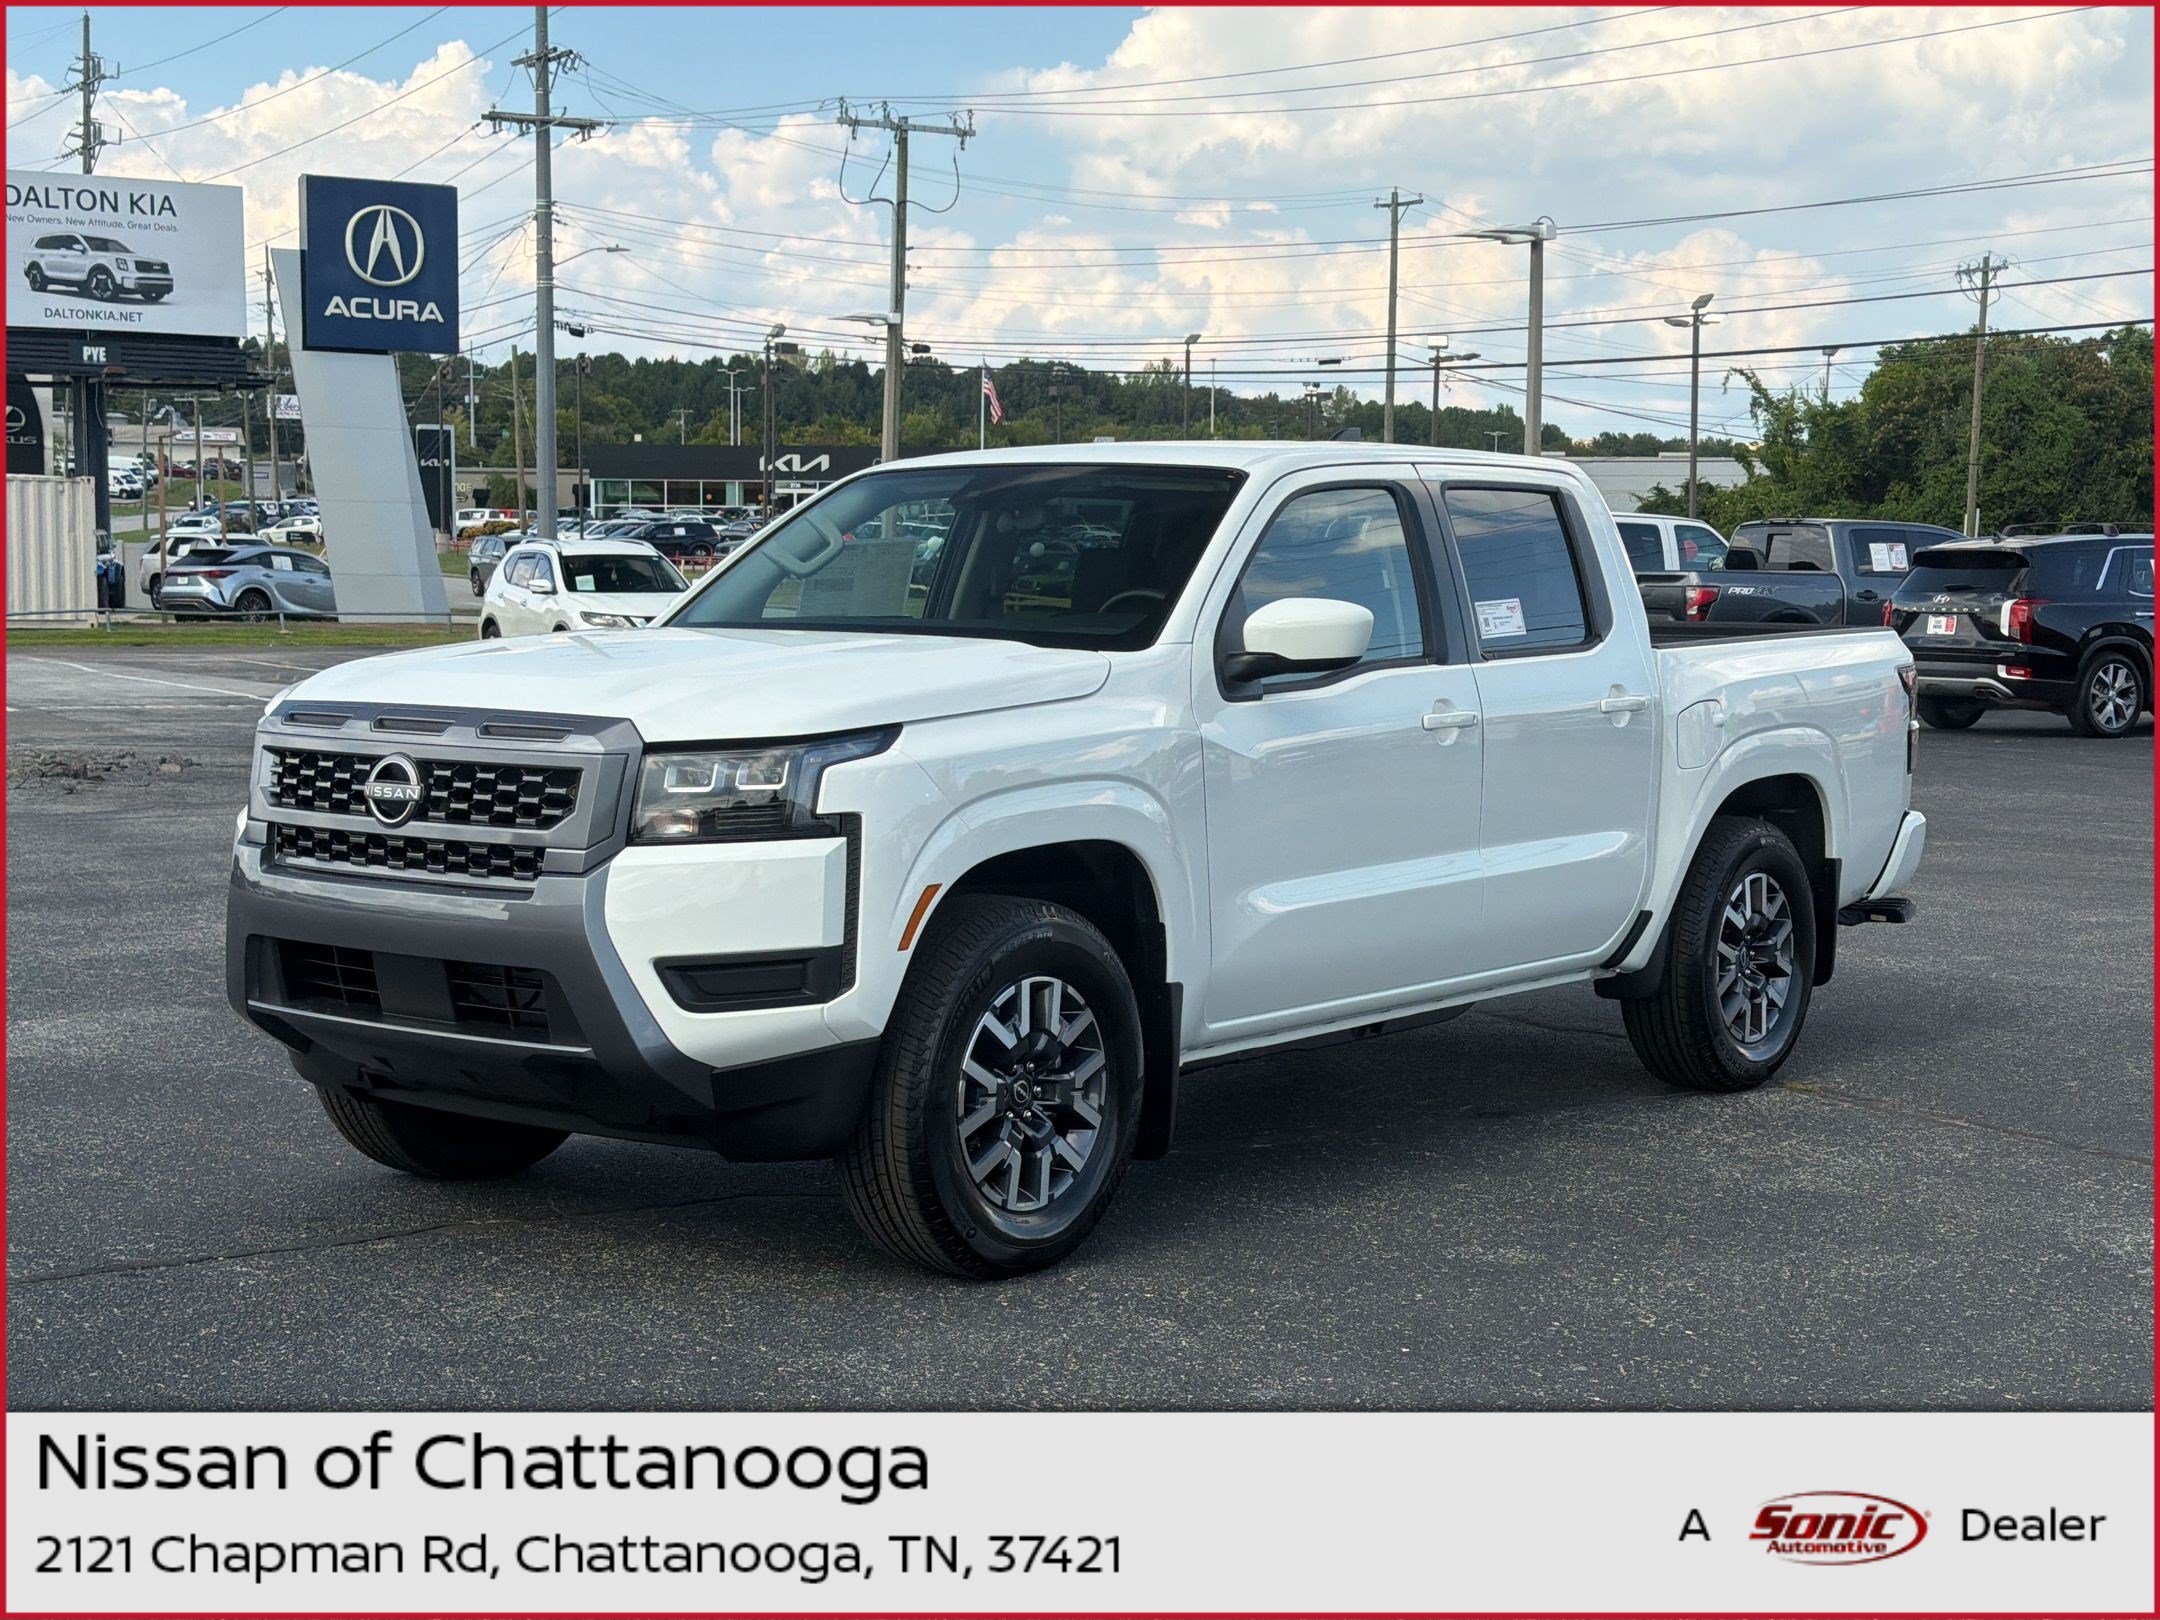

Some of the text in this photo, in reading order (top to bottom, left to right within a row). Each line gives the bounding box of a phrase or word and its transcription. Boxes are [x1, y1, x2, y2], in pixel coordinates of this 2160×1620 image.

[6, 184, 178, 218] DALTON KIA
[6, 214, 179, 233] New Owners. New Attitude. Great Deals.
[44, 307, 144, 323] DALTONKIA.NET
[324, 295, 445, 323] ACURA
[82, 346, 107, 362] PYE
[364, 785, 419, 800] NISSAN
